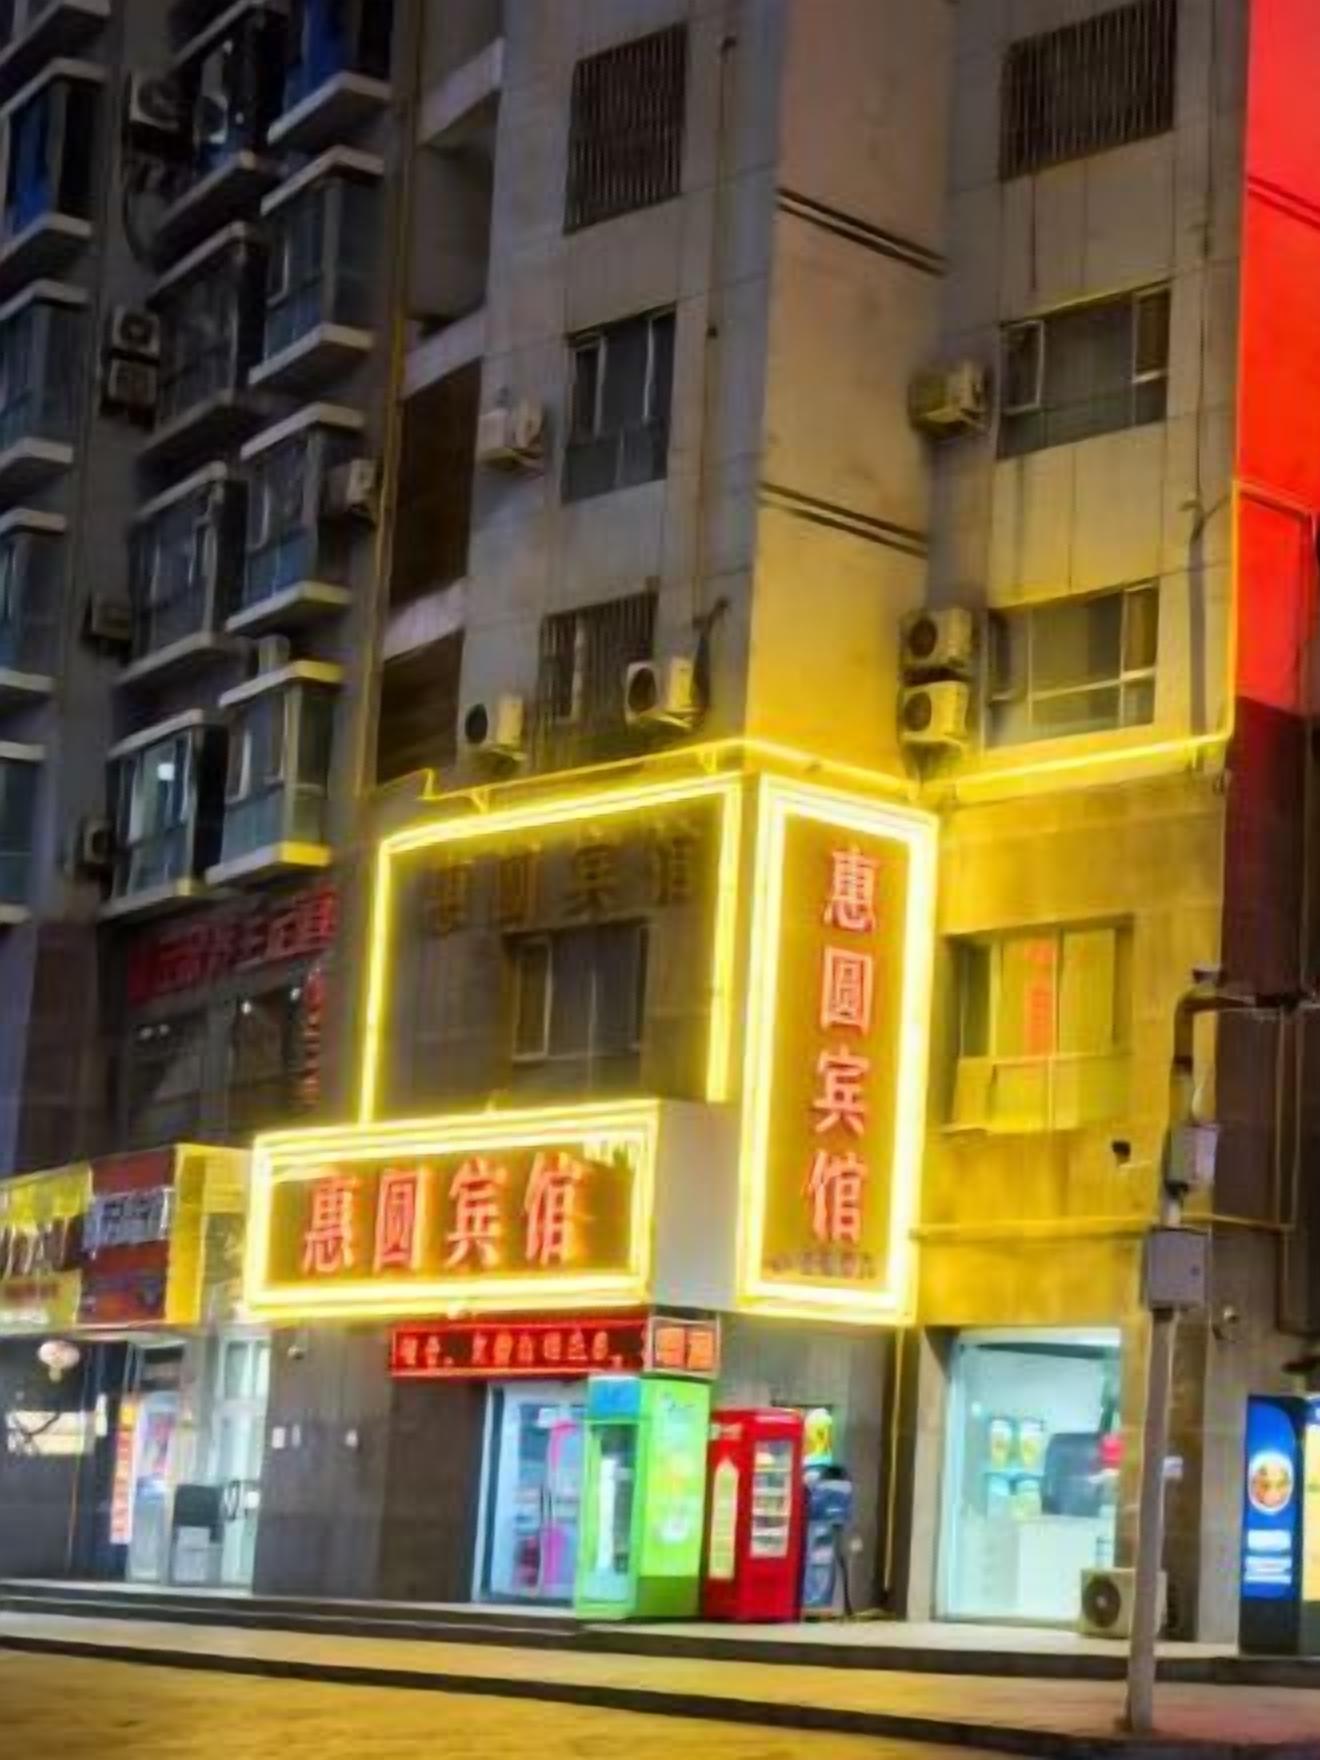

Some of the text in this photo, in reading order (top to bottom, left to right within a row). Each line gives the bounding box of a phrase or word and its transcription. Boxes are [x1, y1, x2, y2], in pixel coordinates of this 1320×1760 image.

[802, 845, 881, 1246] 惠圆宾馆
[301, 1150, 590, 1273] 惠圆宾馆
